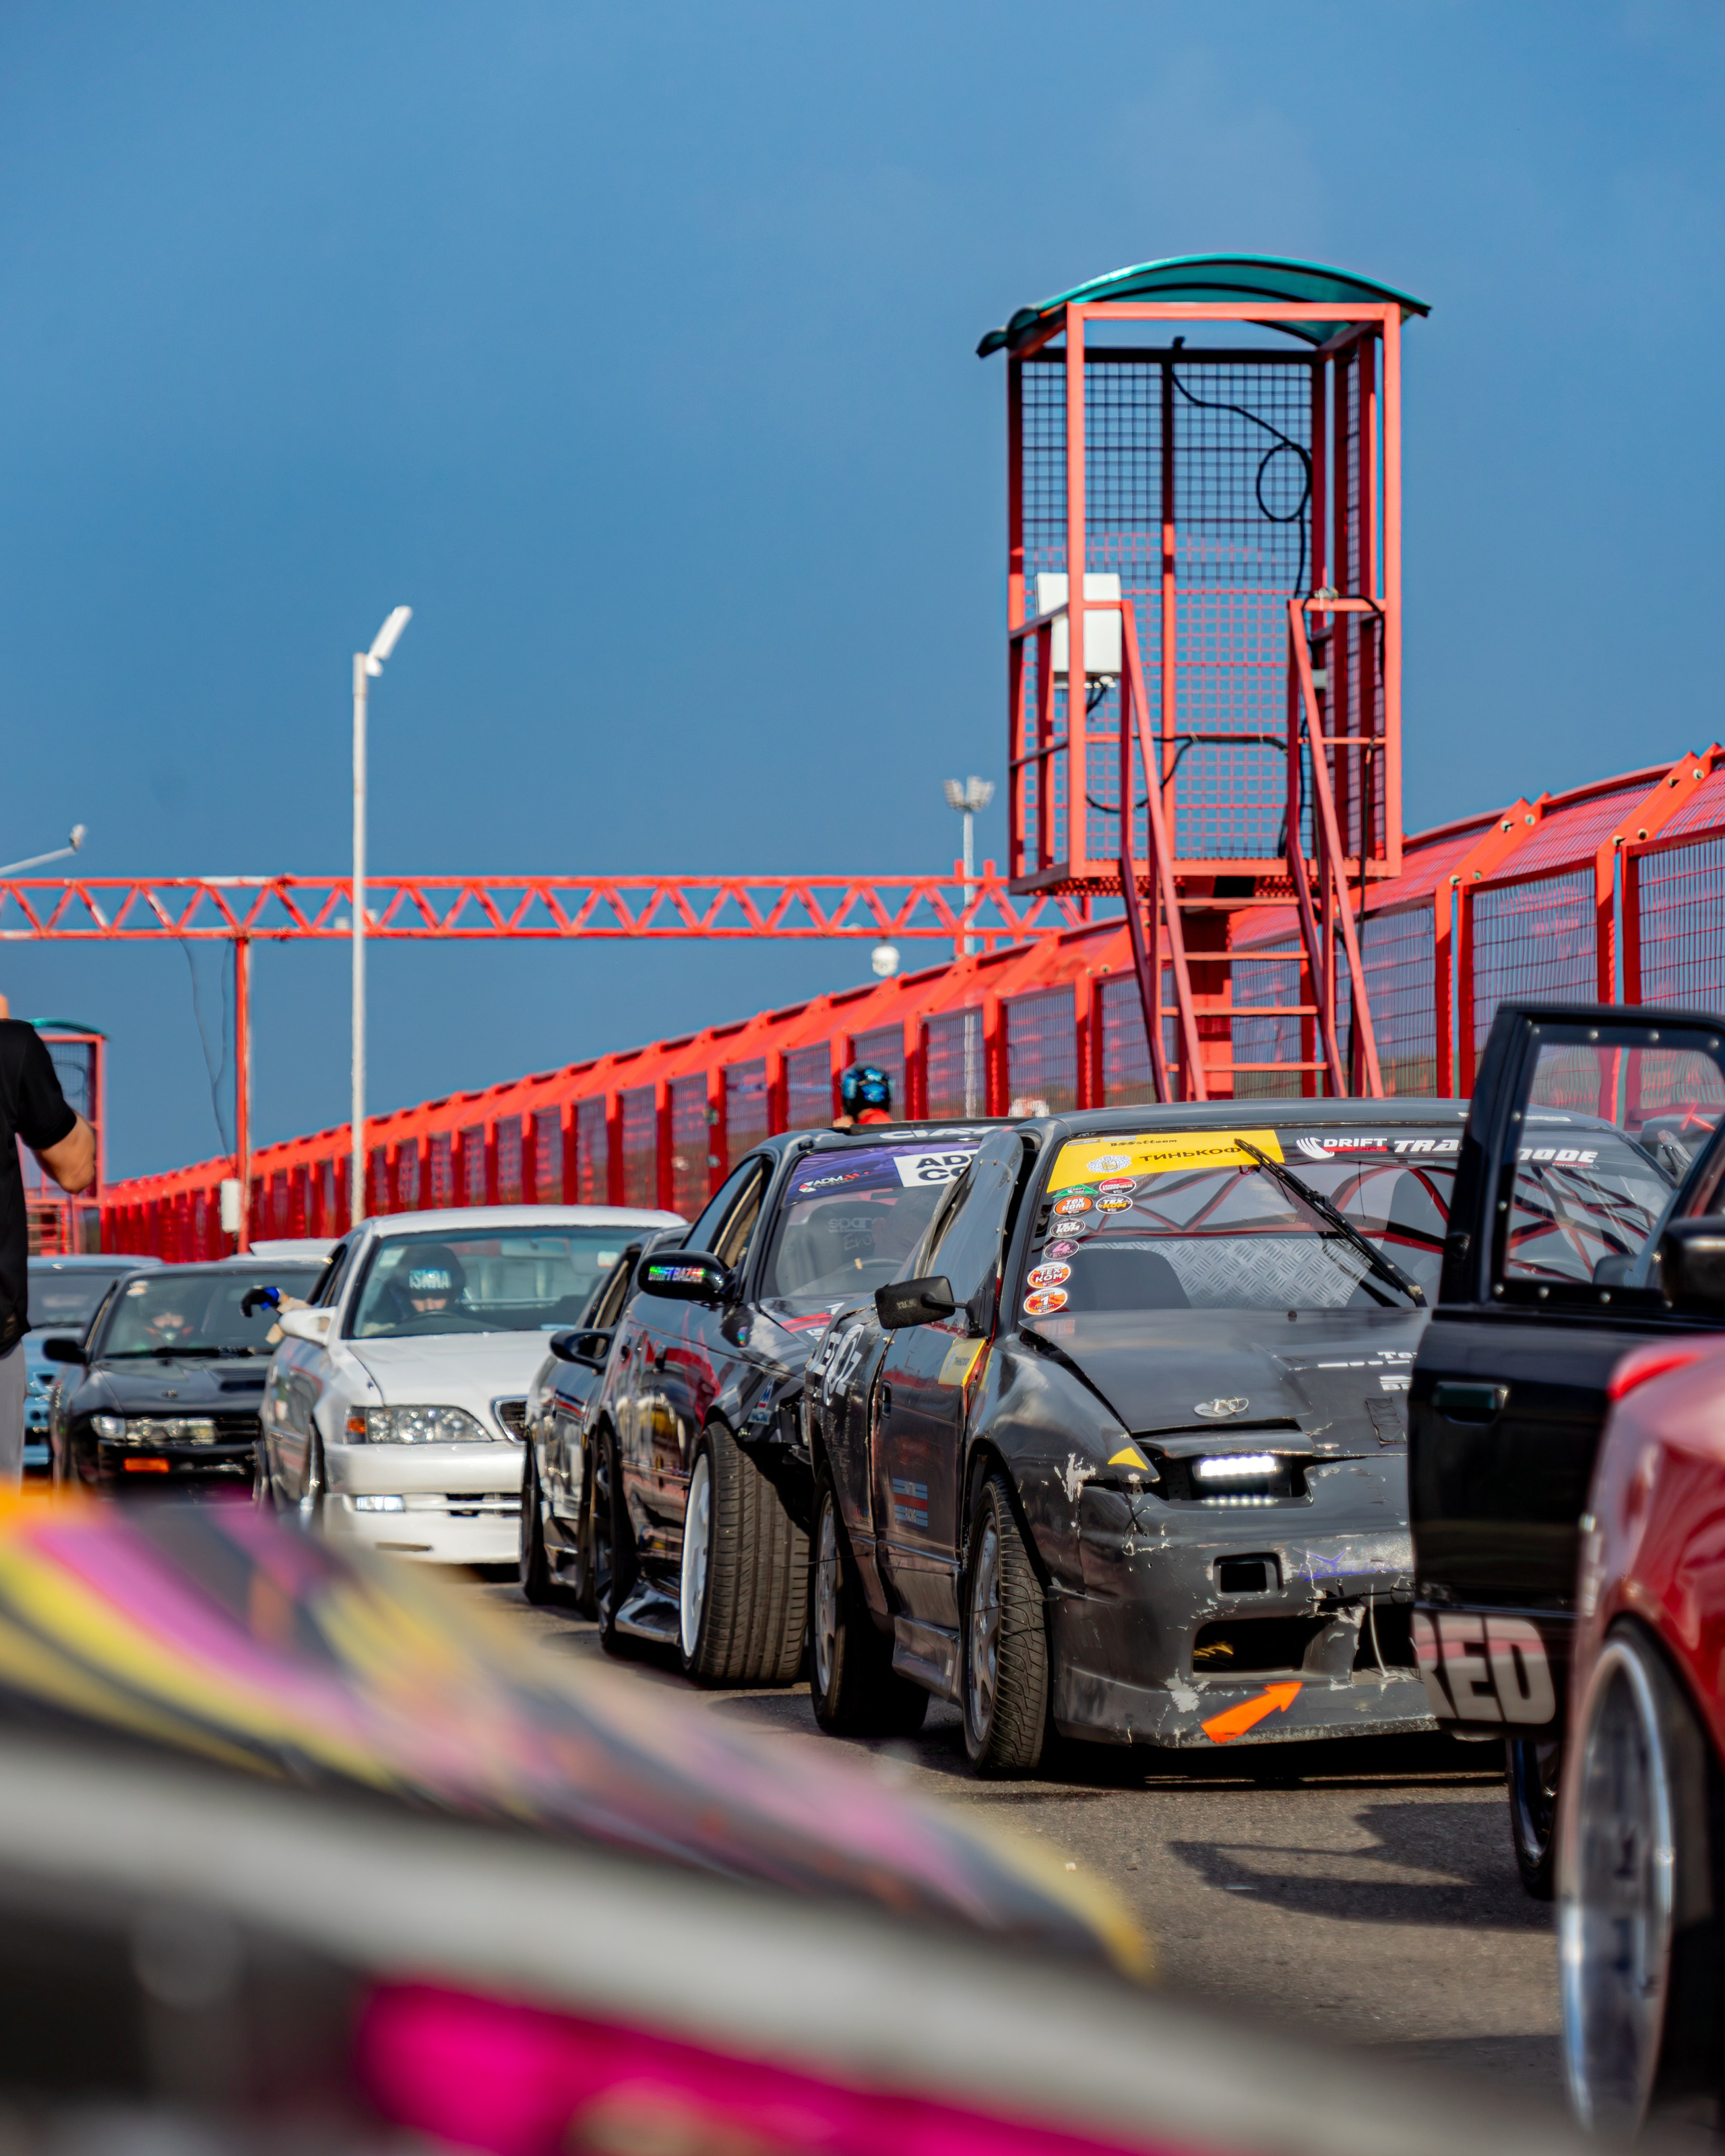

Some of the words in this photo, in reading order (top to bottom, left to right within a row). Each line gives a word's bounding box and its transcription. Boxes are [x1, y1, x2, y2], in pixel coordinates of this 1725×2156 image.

[1323, 1138, 1387, 1147] DRIFT
[813, 1175, 844, 1186] ADM
[1040, 1295, 1050, 1306] 1
